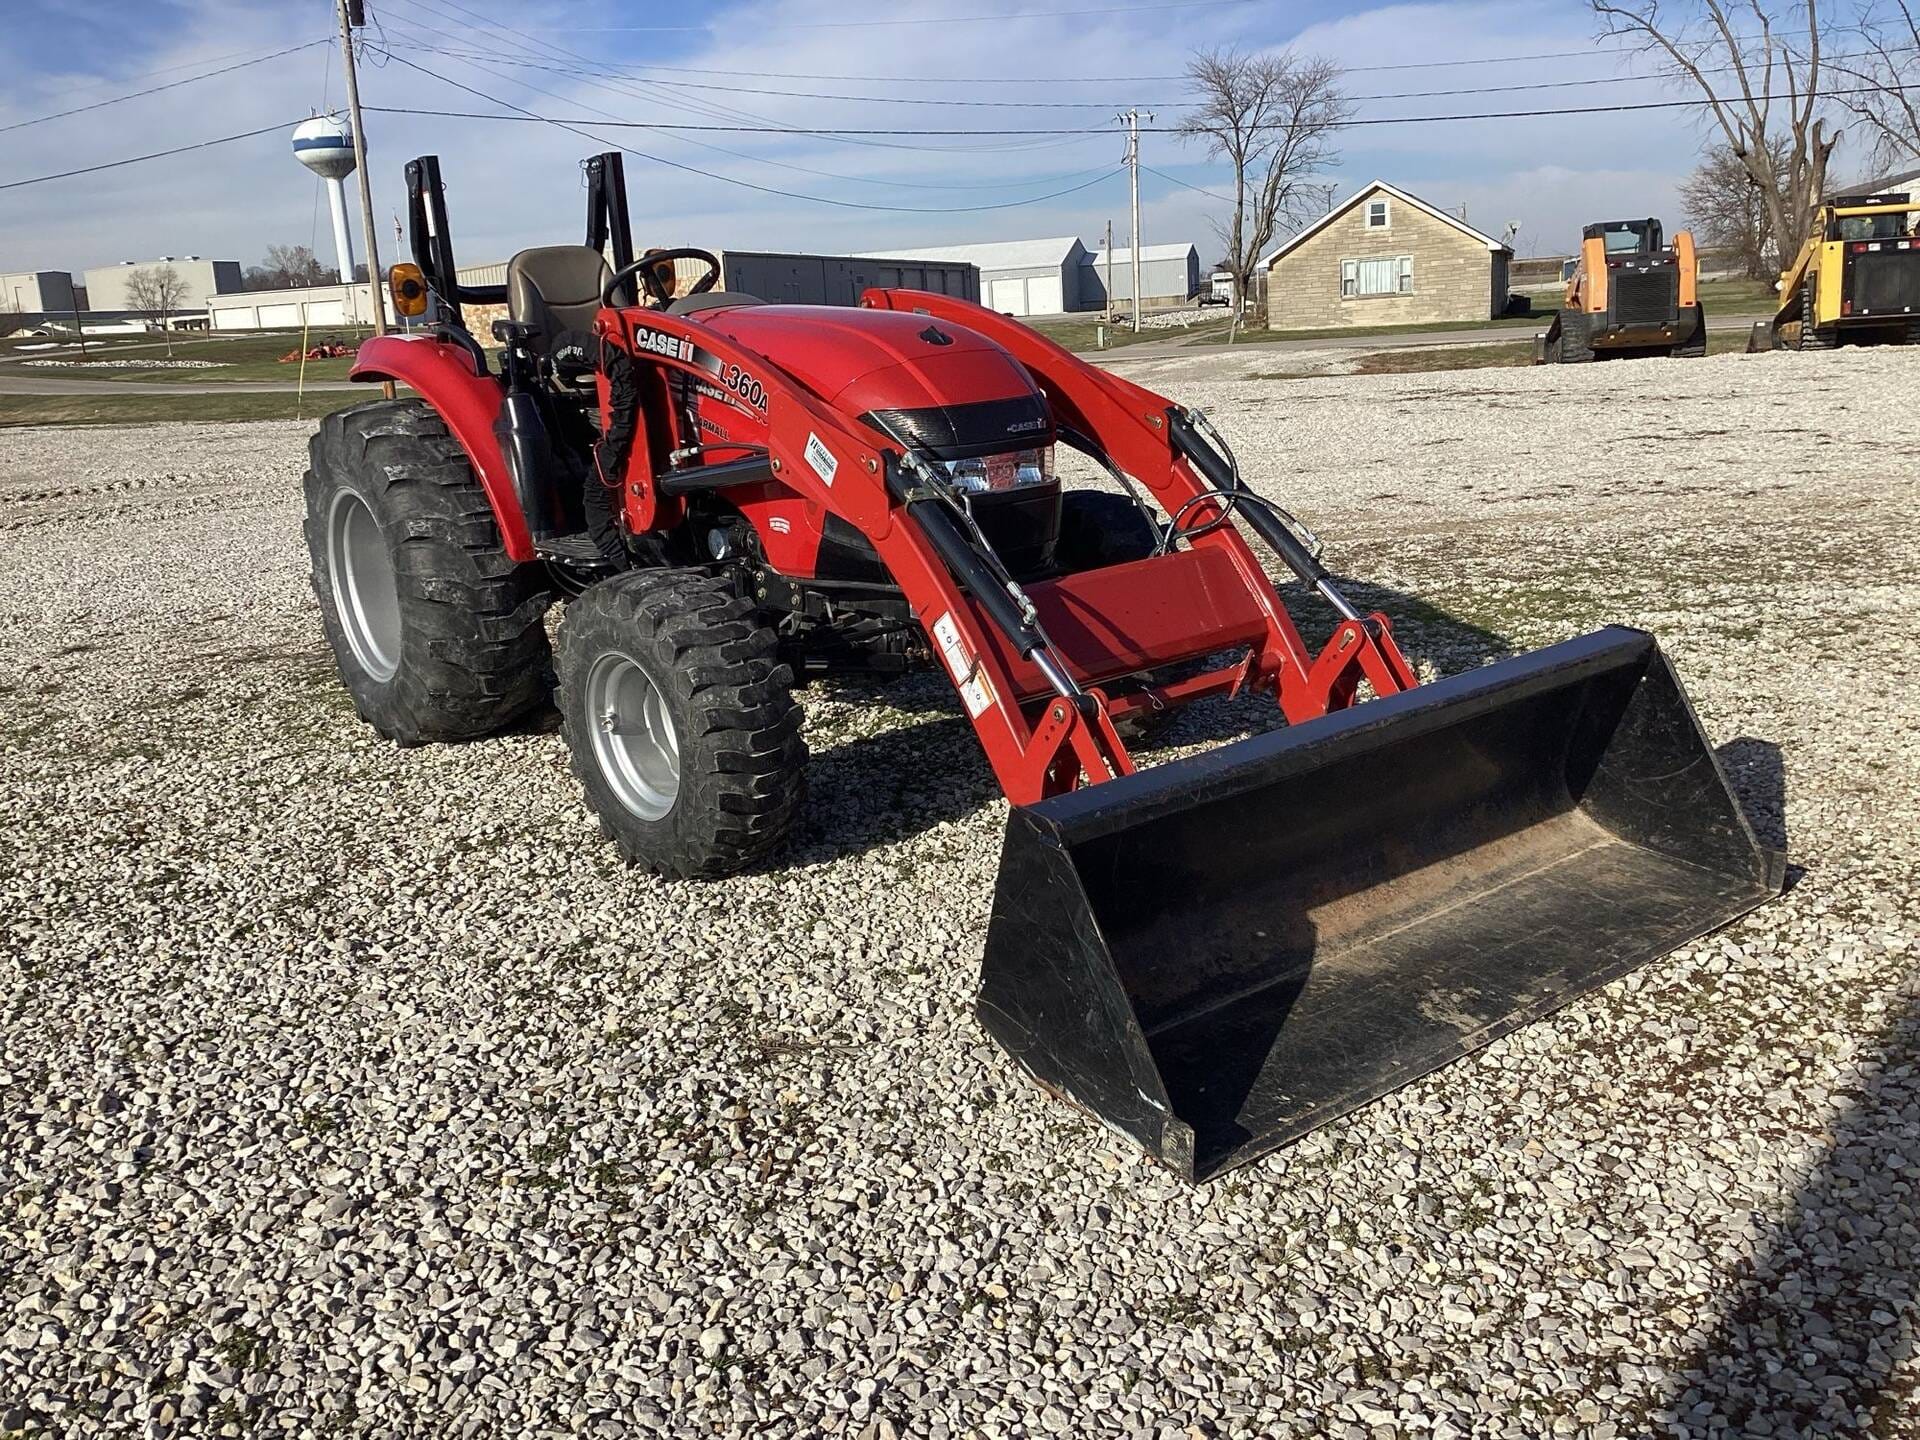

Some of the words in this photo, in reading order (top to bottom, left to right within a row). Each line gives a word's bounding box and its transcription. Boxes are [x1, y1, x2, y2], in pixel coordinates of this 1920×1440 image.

[636, 328, 678, 358] CASE
[718, 362, 769, 414] L360A
[698, 418, 729, 439] ARMALL
